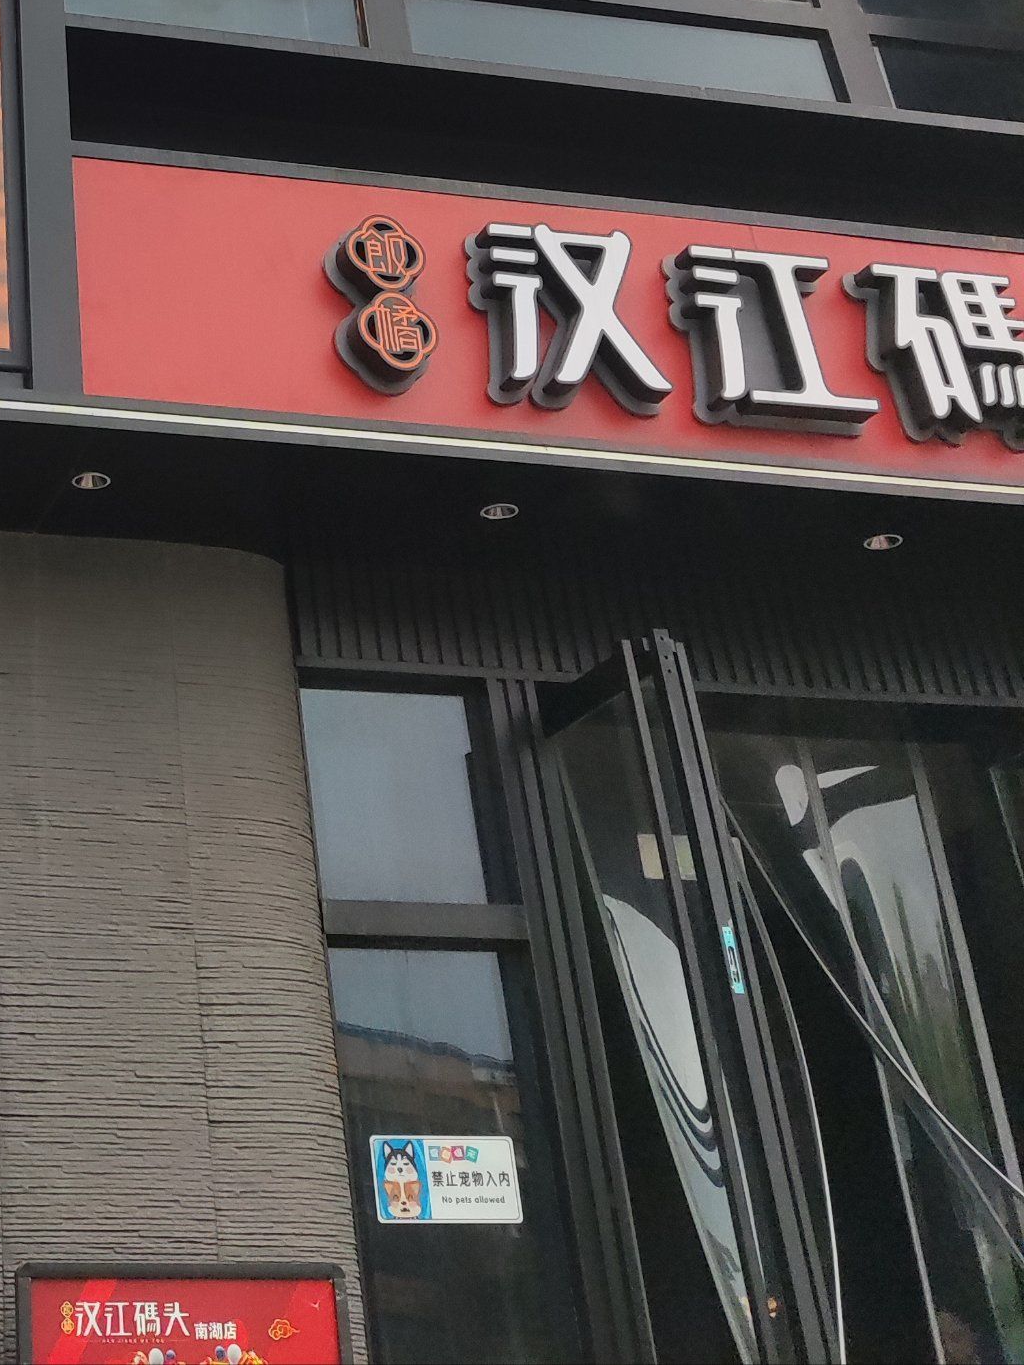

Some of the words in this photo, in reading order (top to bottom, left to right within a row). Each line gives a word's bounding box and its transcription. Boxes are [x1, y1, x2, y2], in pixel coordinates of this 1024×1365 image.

[431, 1170, 511, 1188] 禁止宠物入内
[441, 1195, 453, 1204] No
[455, 1195, 472, 1207] pets
[474, 1195, 505, 1204] allowed
[193, 1322, 237, 1340] 南湖店
